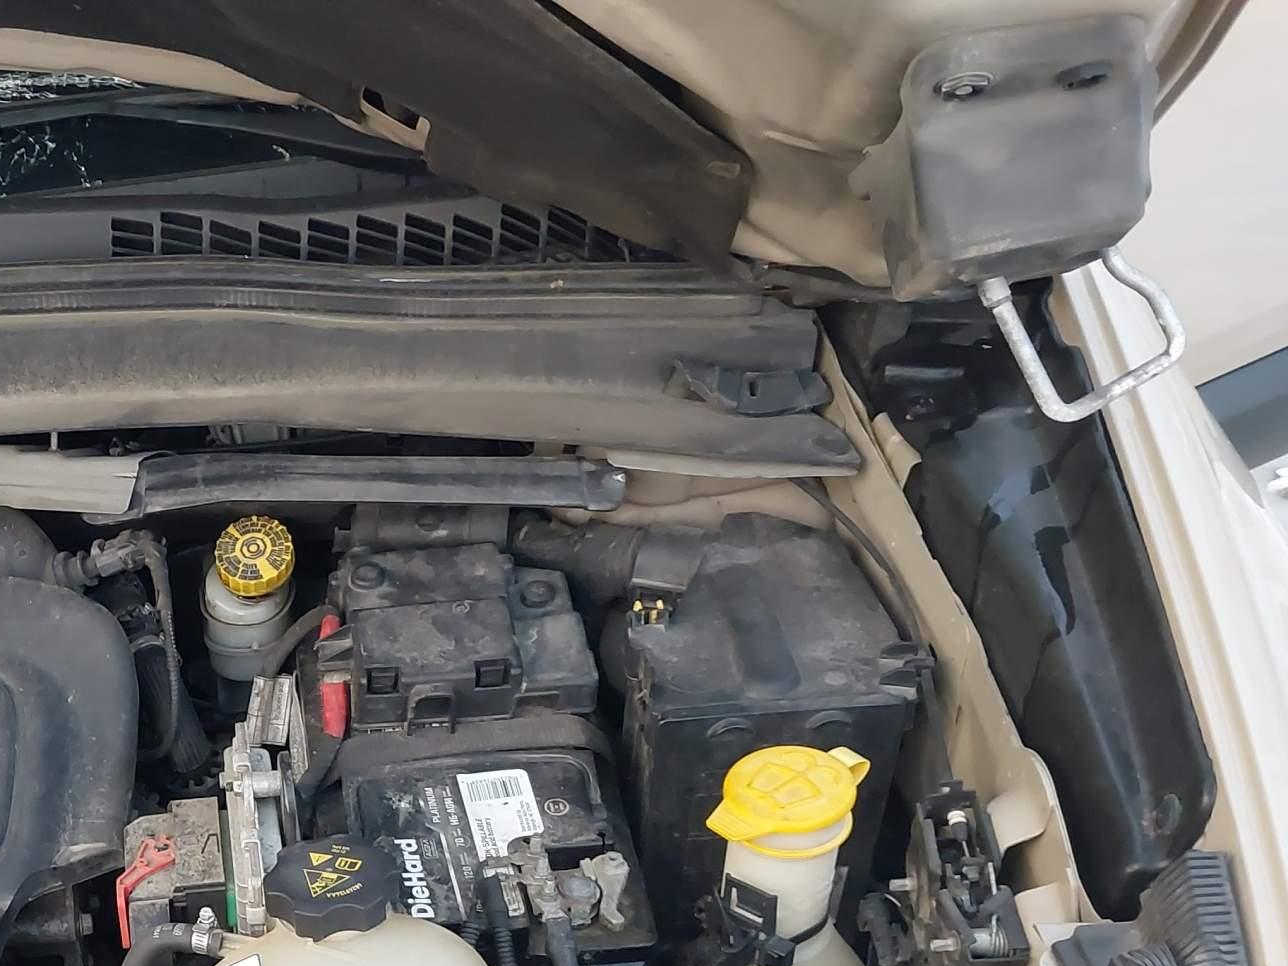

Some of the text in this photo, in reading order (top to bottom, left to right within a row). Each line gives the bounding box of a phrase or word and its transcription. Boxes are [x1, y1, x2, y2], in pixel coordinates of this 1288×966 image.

[424, 787, 441, 823] PLATINUM
[394, 838, 435, 918] DieHard
[463, 866, 475, 879] 120
